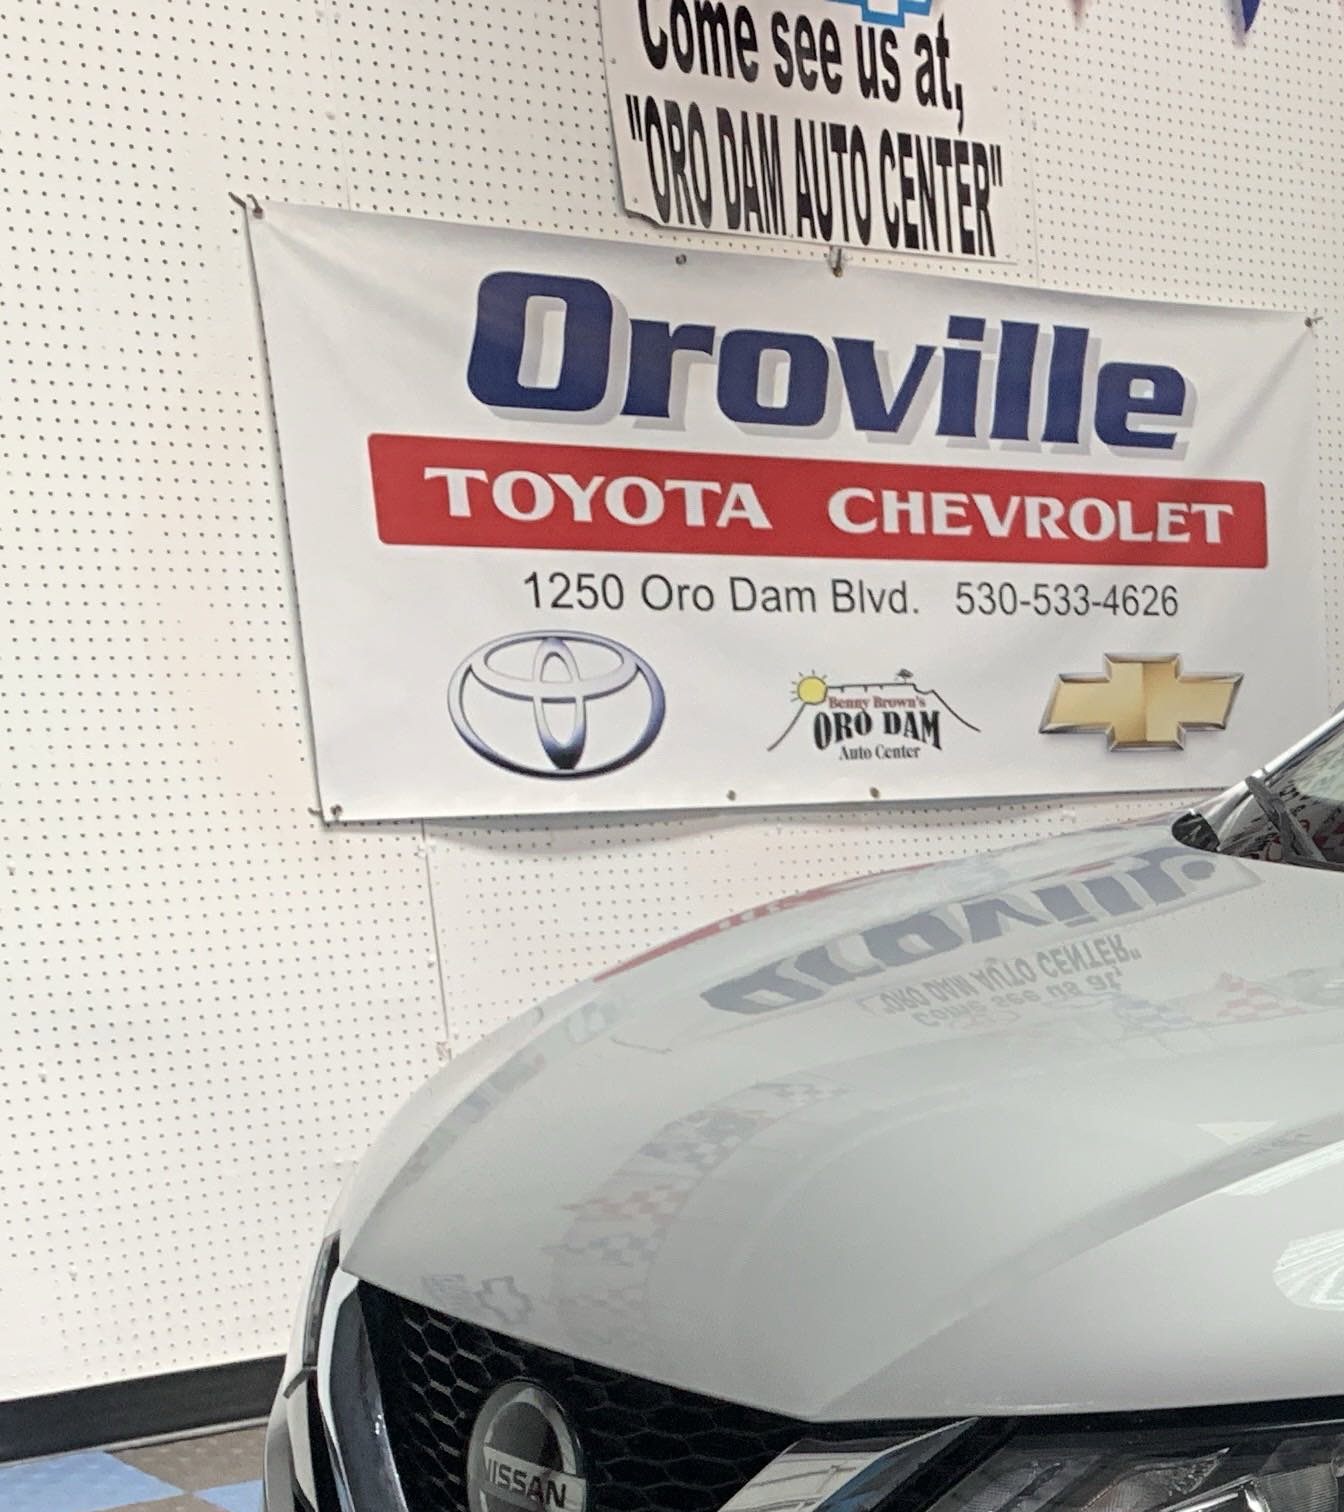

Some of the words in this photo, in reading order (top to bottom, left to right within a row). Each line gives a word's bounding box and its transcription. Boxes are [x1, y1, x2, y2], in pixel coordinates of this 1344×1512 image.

[639, 0, 759, 83] Come
[771, 11, 843, 95] see
[854, 23, 901, 103] us
[913, 13, 964, 135] at,
[625, 94, 713, 230] "ORO
[716, 106, 787, 236] DAM
[794, 118, 873, 246] AUTO
[879, 128, 1003, 258] CENTER"
[466, 270, 1186, 450] Oroville
[424, 466, 773, 531] TOYOTA
[827, 487, 1235, 545] CHEVROLET
[523, 571, 625, 611] 1250
[640, 573, 715, 612] Oro
[729, 576, 817, 613] Dam
[830, 578, 920, 615] Blvd.
[955, 581, 1179, 617] 530-533-4626
[813, 710, 873, 751] ORO
[883, 710, 943, 751] DAM
[828, 696, 871, 711] Benny
[873, 695, 927, 709] Brown's
[838, 746, 873, 761] Auto
[875, 745, 921, 760] Center
